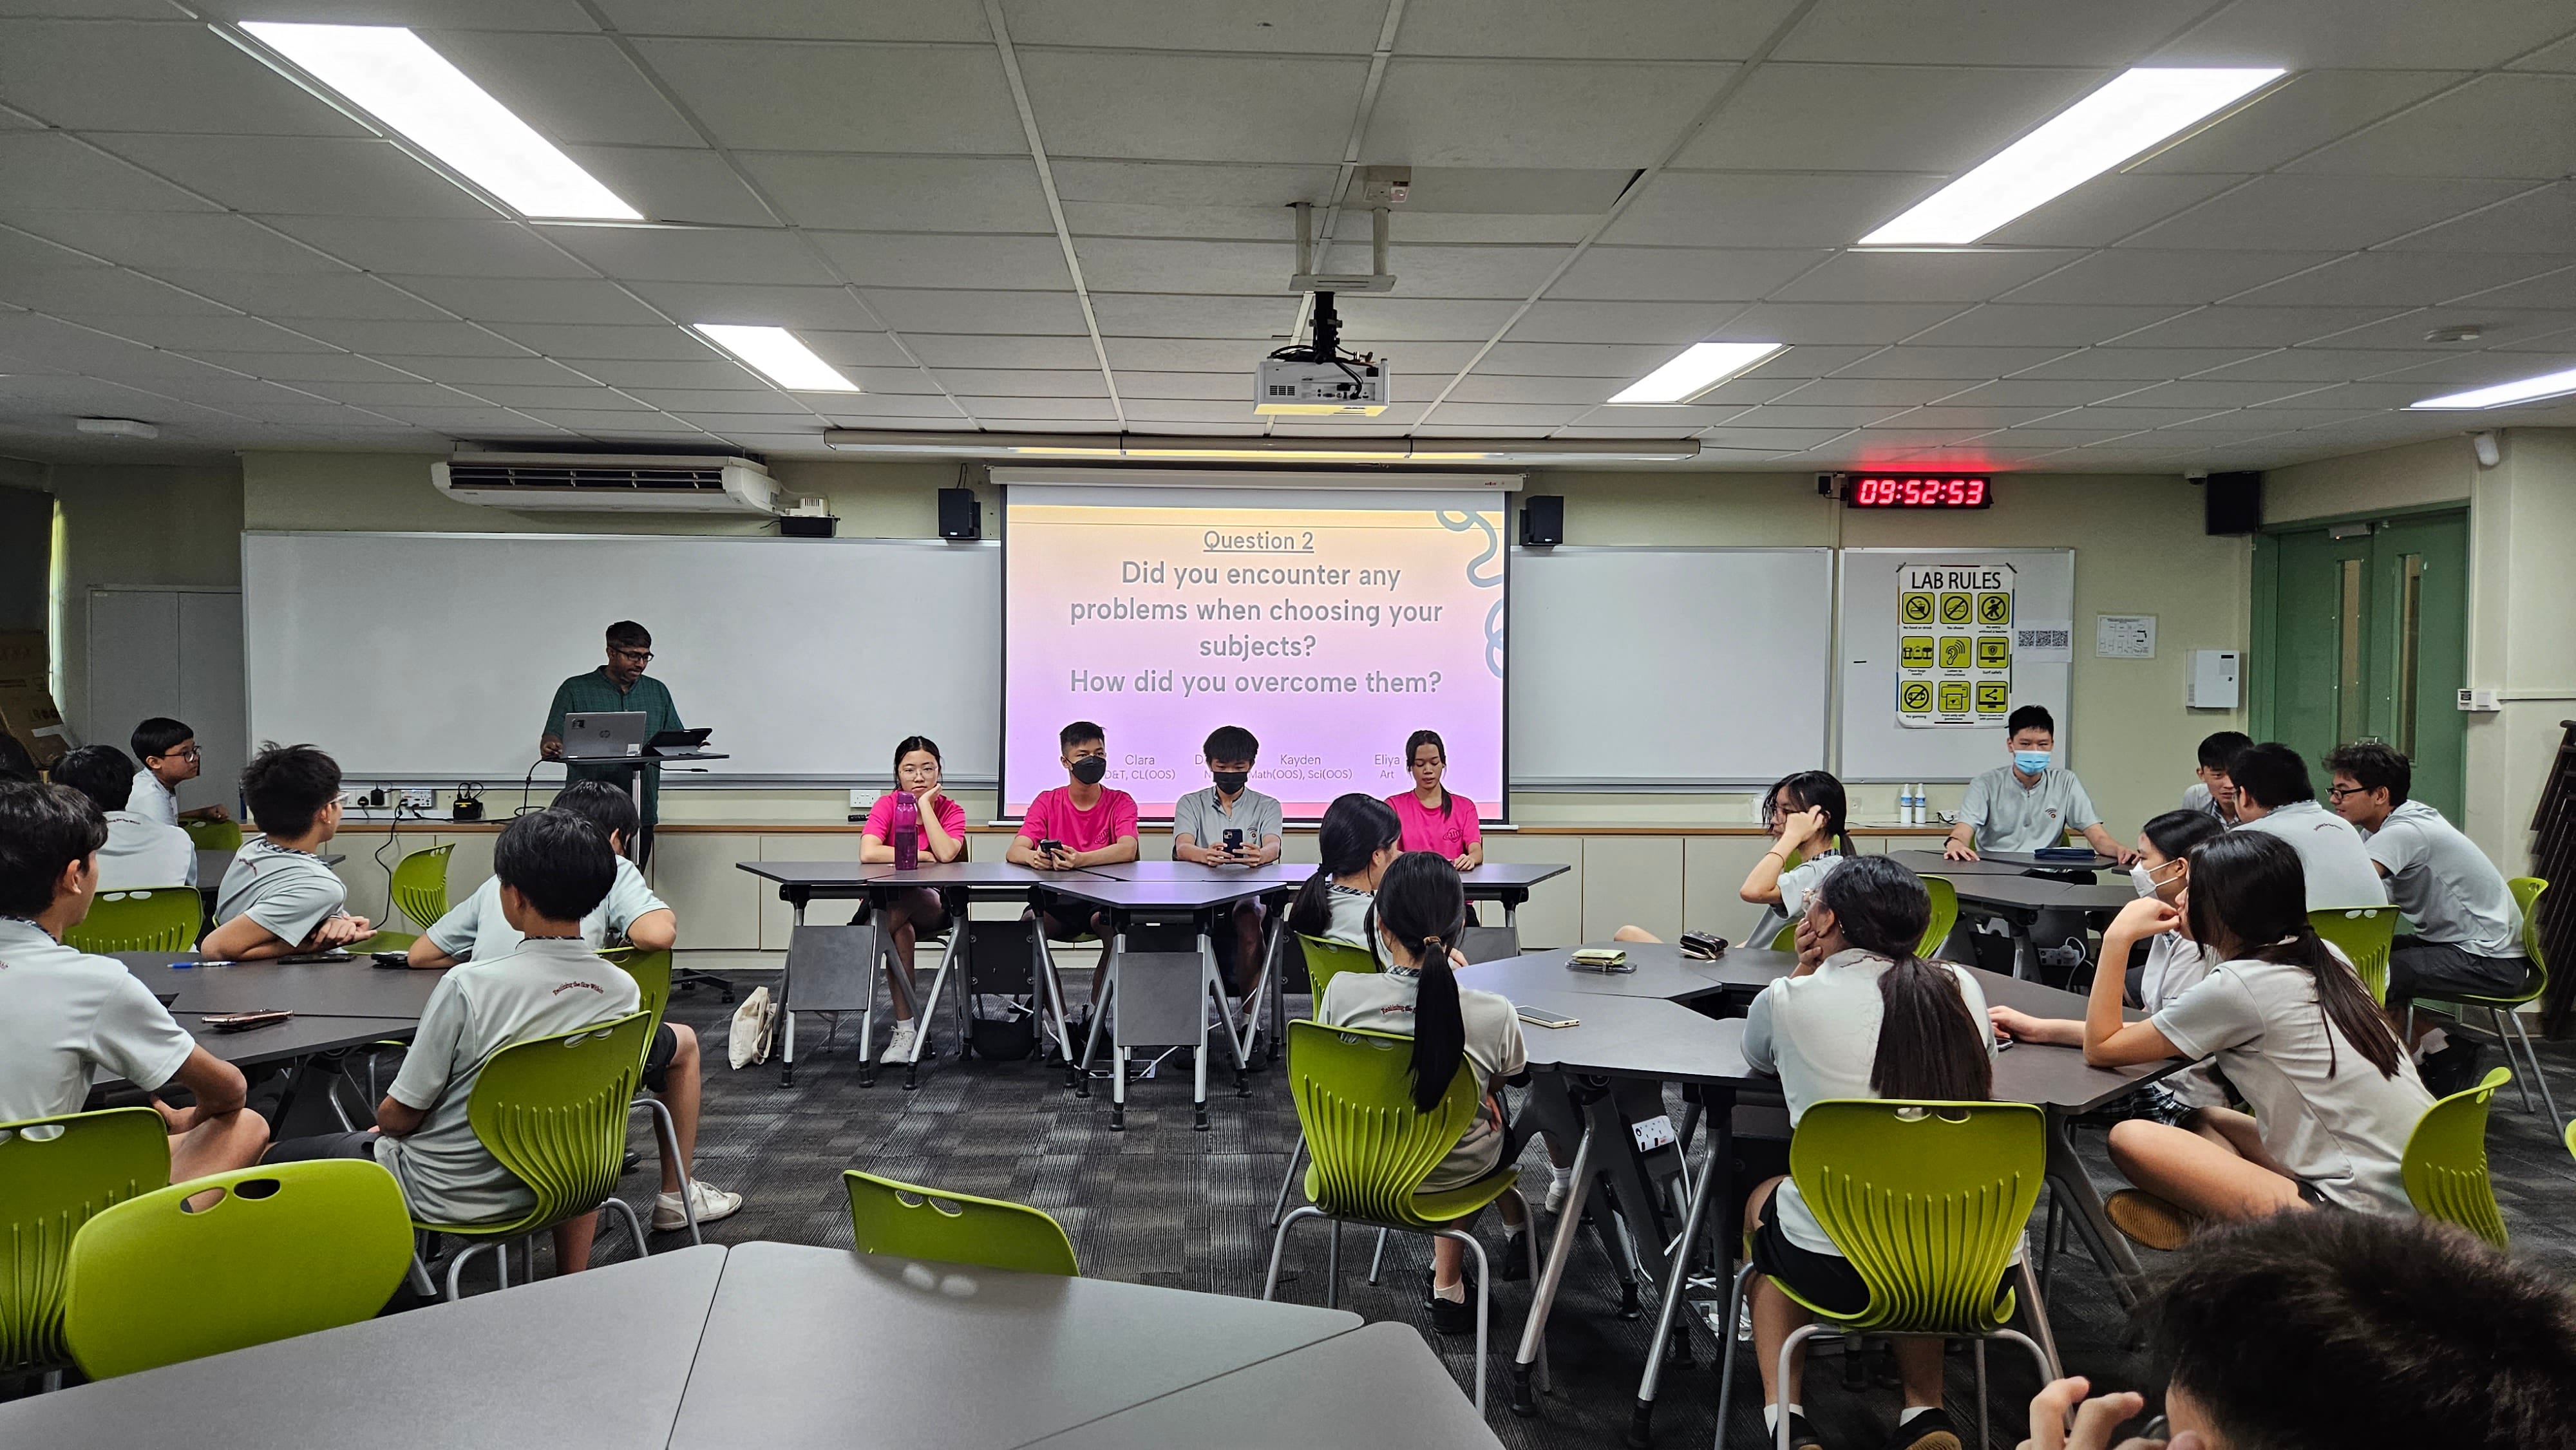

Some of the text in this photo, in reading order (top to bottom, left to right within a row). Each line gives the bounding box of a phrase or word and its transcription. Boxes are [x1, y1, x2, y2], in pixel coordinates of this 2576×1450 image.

[1859, 480, 1984, 504] 09:52:53
[1204, 530, 1314, 549] Question 2
[1122, 560, 1401, 592] Did you encounter any
[1911, 572, 2001, 589] LAB RULES
[1071, 597, 1443, 628] problems when choosing your
[1200, 634, 1316, 662] subjects?
[1071, 669, 1441, 698] How did you overcome them?
[1125, 754, 1155, 766] Clara
[1280, 754, 1321, 767] Kayden
[1374, 754, 1400, 767] Eliya
[1104, 769, 1176, 781] D&T, CL(OOS)
[1249, 769, 1352, 780] Math(OOS), Sci(OOS)
[1379, 769, 1394, 778] Art
